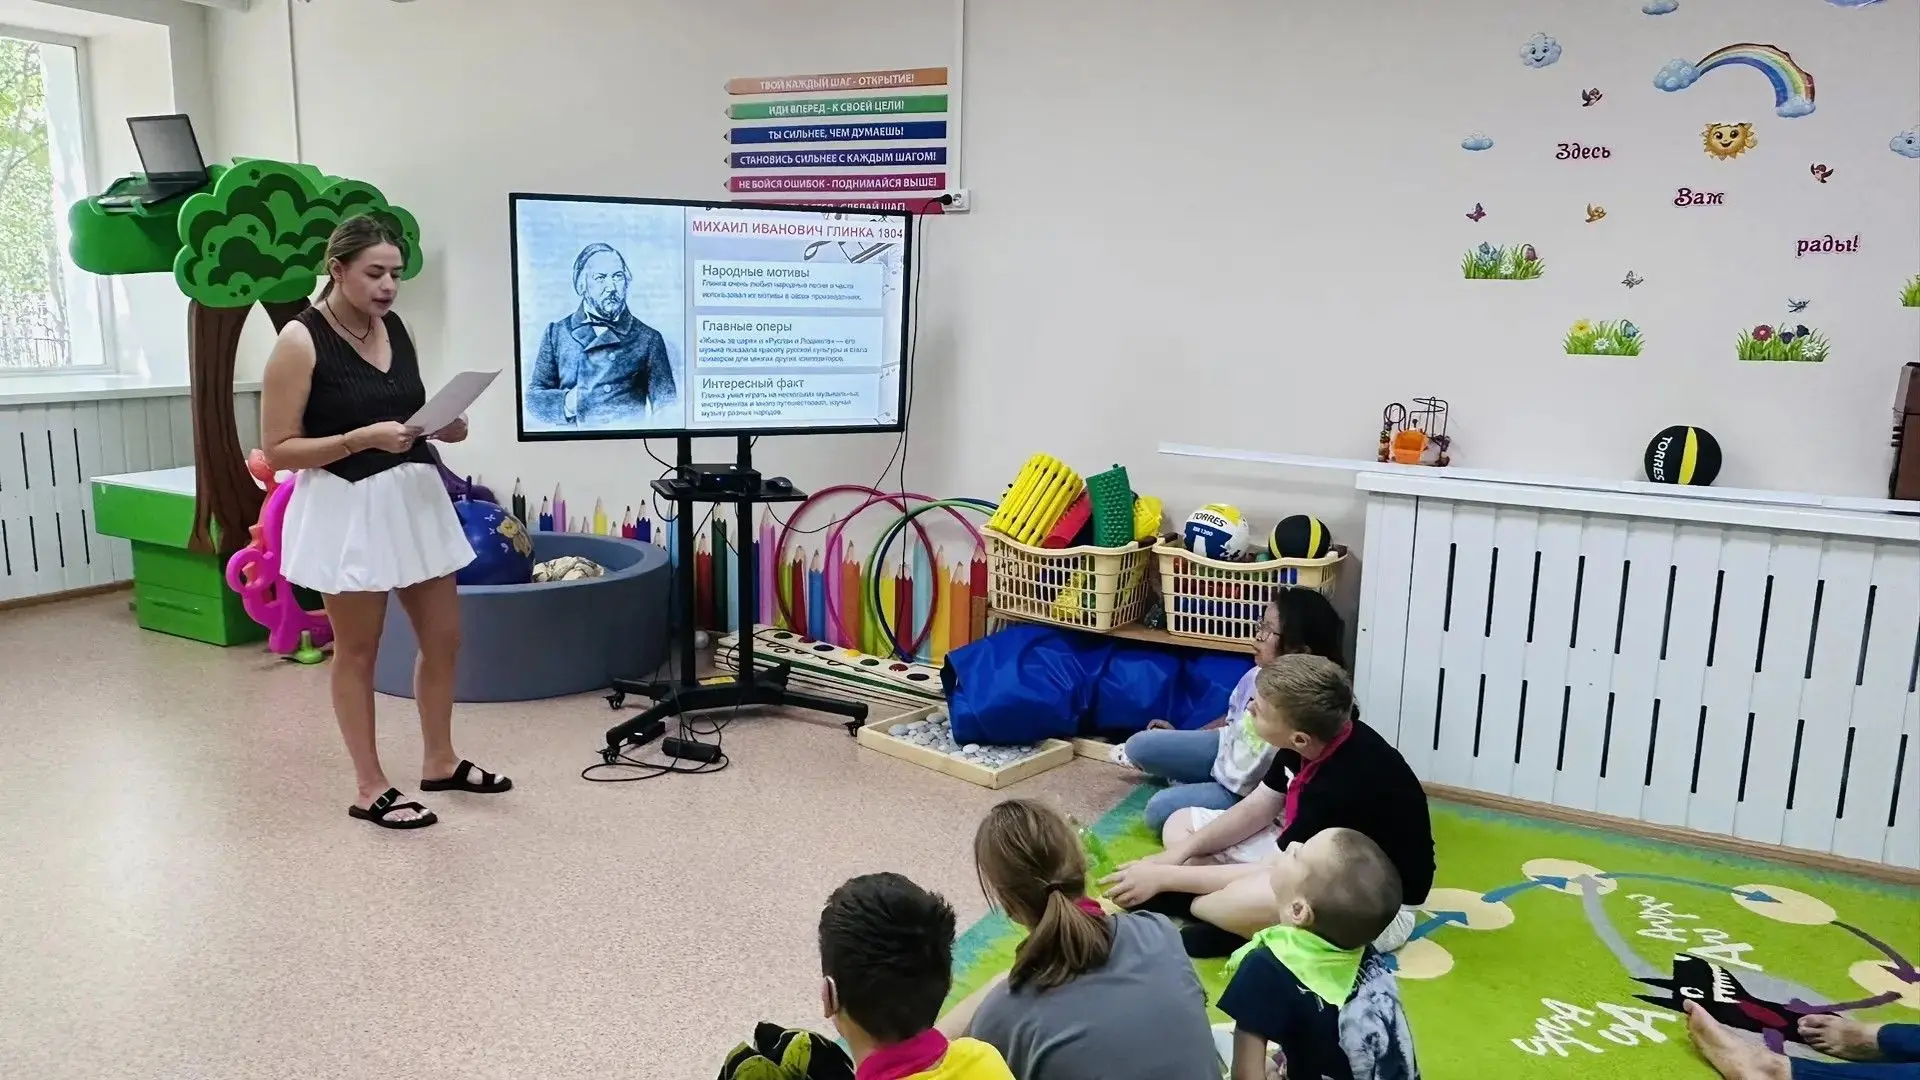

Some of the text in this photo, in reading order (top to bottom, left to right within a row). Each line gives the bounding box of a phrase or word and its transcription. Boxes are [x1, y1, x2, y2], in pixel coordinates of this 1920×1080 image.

[760, 80, 785, 91] ТВОЙ
[785, 78, 828, 91] КАЖДЫЙ
[830, 76, 850, 88] ШАГ
[858, 74, 915, 87] ОТКРЫТИЕ!
[768, 104, 788, 117] ИДИ
[790, 103, 825, 116] ВПЕРЕД
[832, 103, 839, 113] К
[840, 101, 872, 112] СВОЕЙ
[874, 101, 905, 112] ЦЕЛИ!
[768, 127, 904, 139] ТЫ СИЛЬНЕЕ, ЧЕМ ДУМАЕШЬ!
[739, 152, 937, 165] СТАНОВИСЬ СИЛЬНЕЕ С КАЖДЫМ ШАГОМ!
[1556, 143, 1611, 160] Здесь
[738, 180, 751, 189] НЕ
[751, 178, 781, 189] БОЙСЯ
[783, 178, 825, 189] ОШИБОК
[831, 177, 901, 189] ПОДНИМАЙСЯ
[903, 176, 937, 187] ВЫШЕ!
[1674, 188, 1725, 206] Вам
[692, 220, 903, 239] МИХАИЛ ИВАНОВИЧ ГЛИНКА 1804
[1797, 235, 1859, 257] рады!
[702, 264, 810, 278] Народные мотивы
[702, 320, 792, 333] Главные оперы
[702, 378, 805, 390] Интересный факт
[1653, 436, 1673, 481] TORRES
[1192, 512, 1228, 527] TORRES
